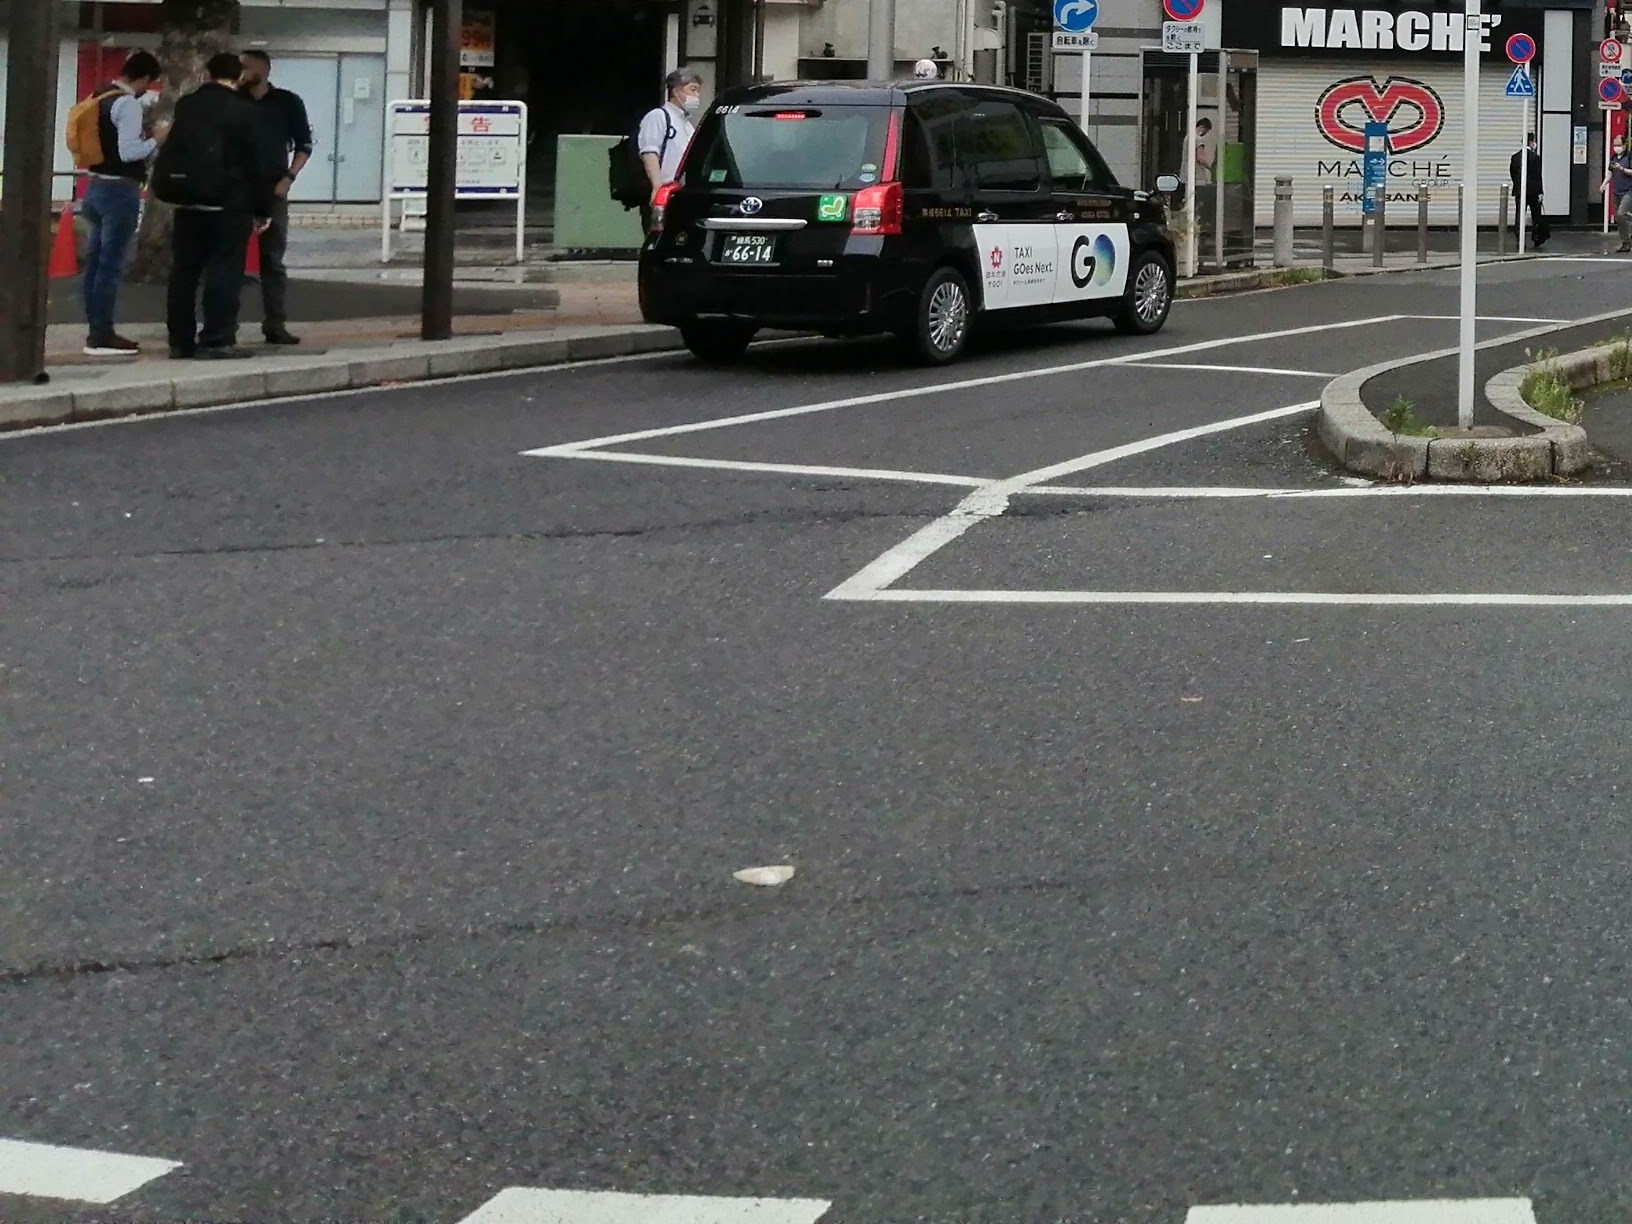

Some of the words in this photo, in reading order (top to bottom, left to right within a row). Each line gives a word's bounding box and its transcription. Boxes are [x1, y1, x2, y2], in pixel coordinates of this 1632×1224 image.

[1056, 36, 1094, 46] 自転車を除く
[1166, 42, 1201, 50] ここまで
[1318, 155, 1452, 178] MACHÉ
[732, 245, 772, 262] 66-14
[1014, 247, 1033, 258] TAXI
[1071, 233, 1116, 289] GO
[1014, 263, 1034, 274] GOes
